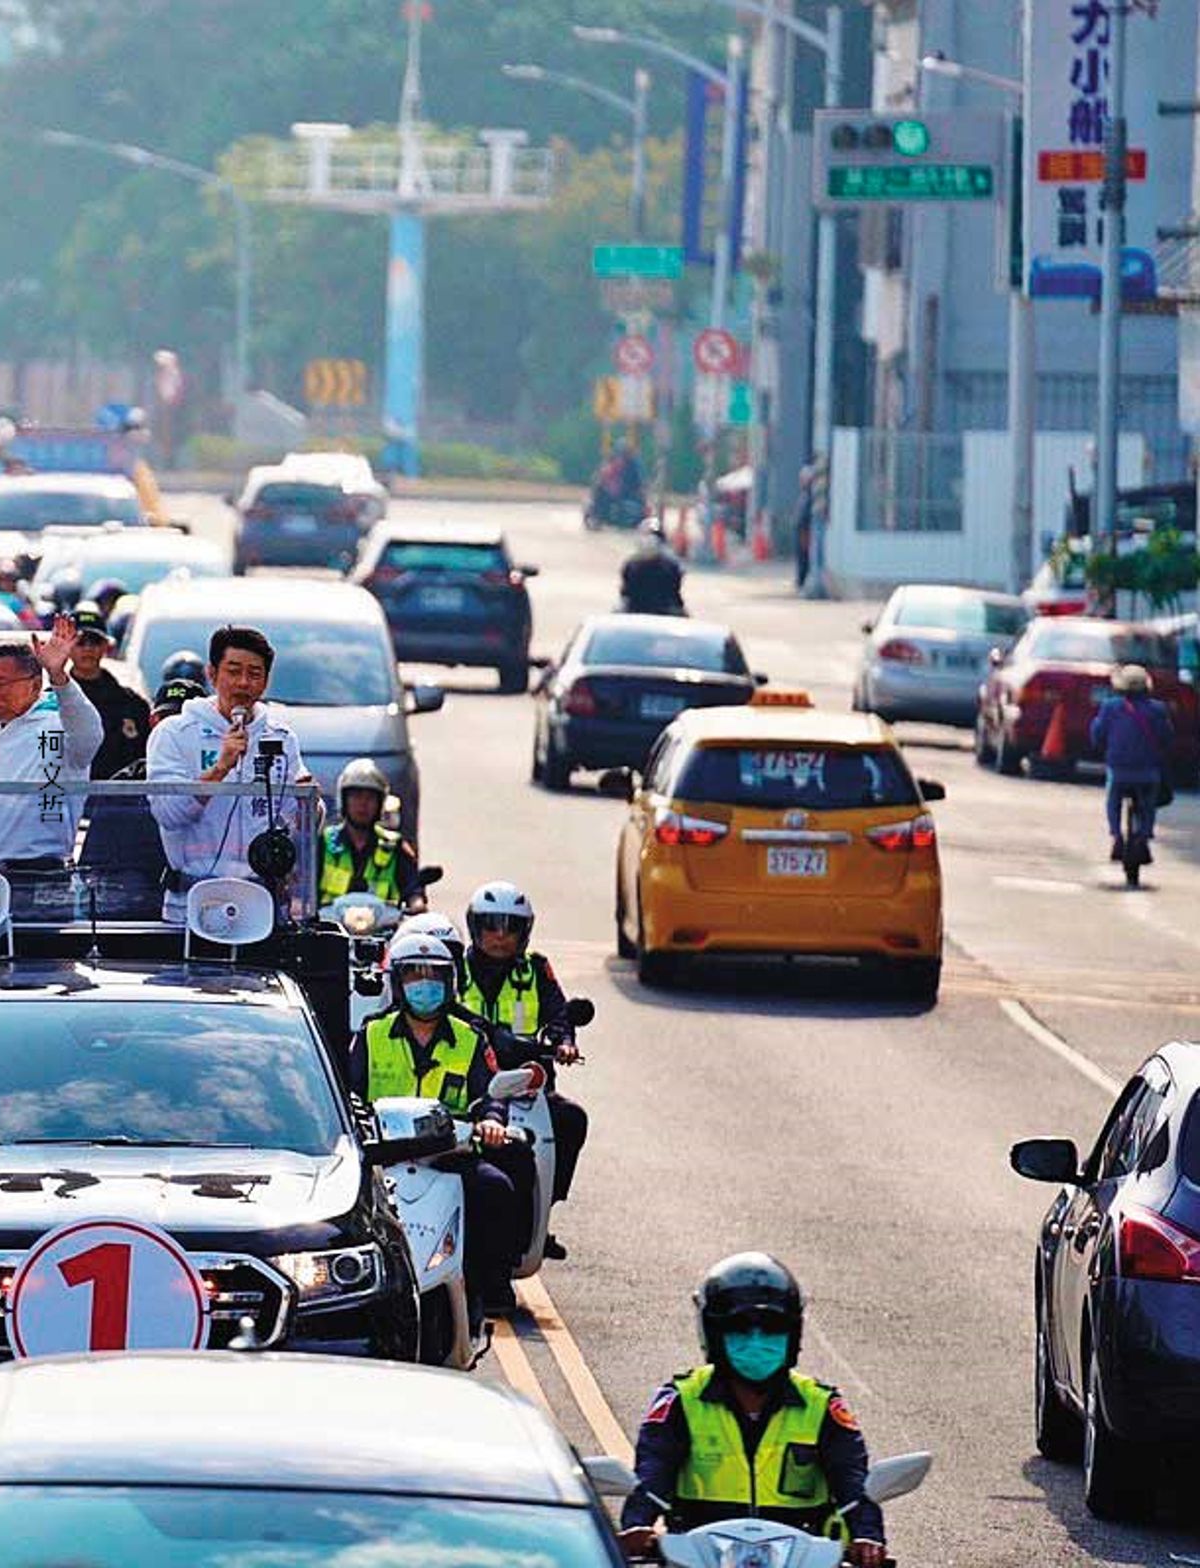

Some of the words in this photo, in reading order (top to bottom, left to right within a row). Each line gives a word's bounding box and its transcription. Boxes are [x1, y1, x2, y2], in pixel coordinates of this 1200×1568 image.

[38, 730, 65, 823] 柯文哲
[57, 1242, 131, 1350] 1
